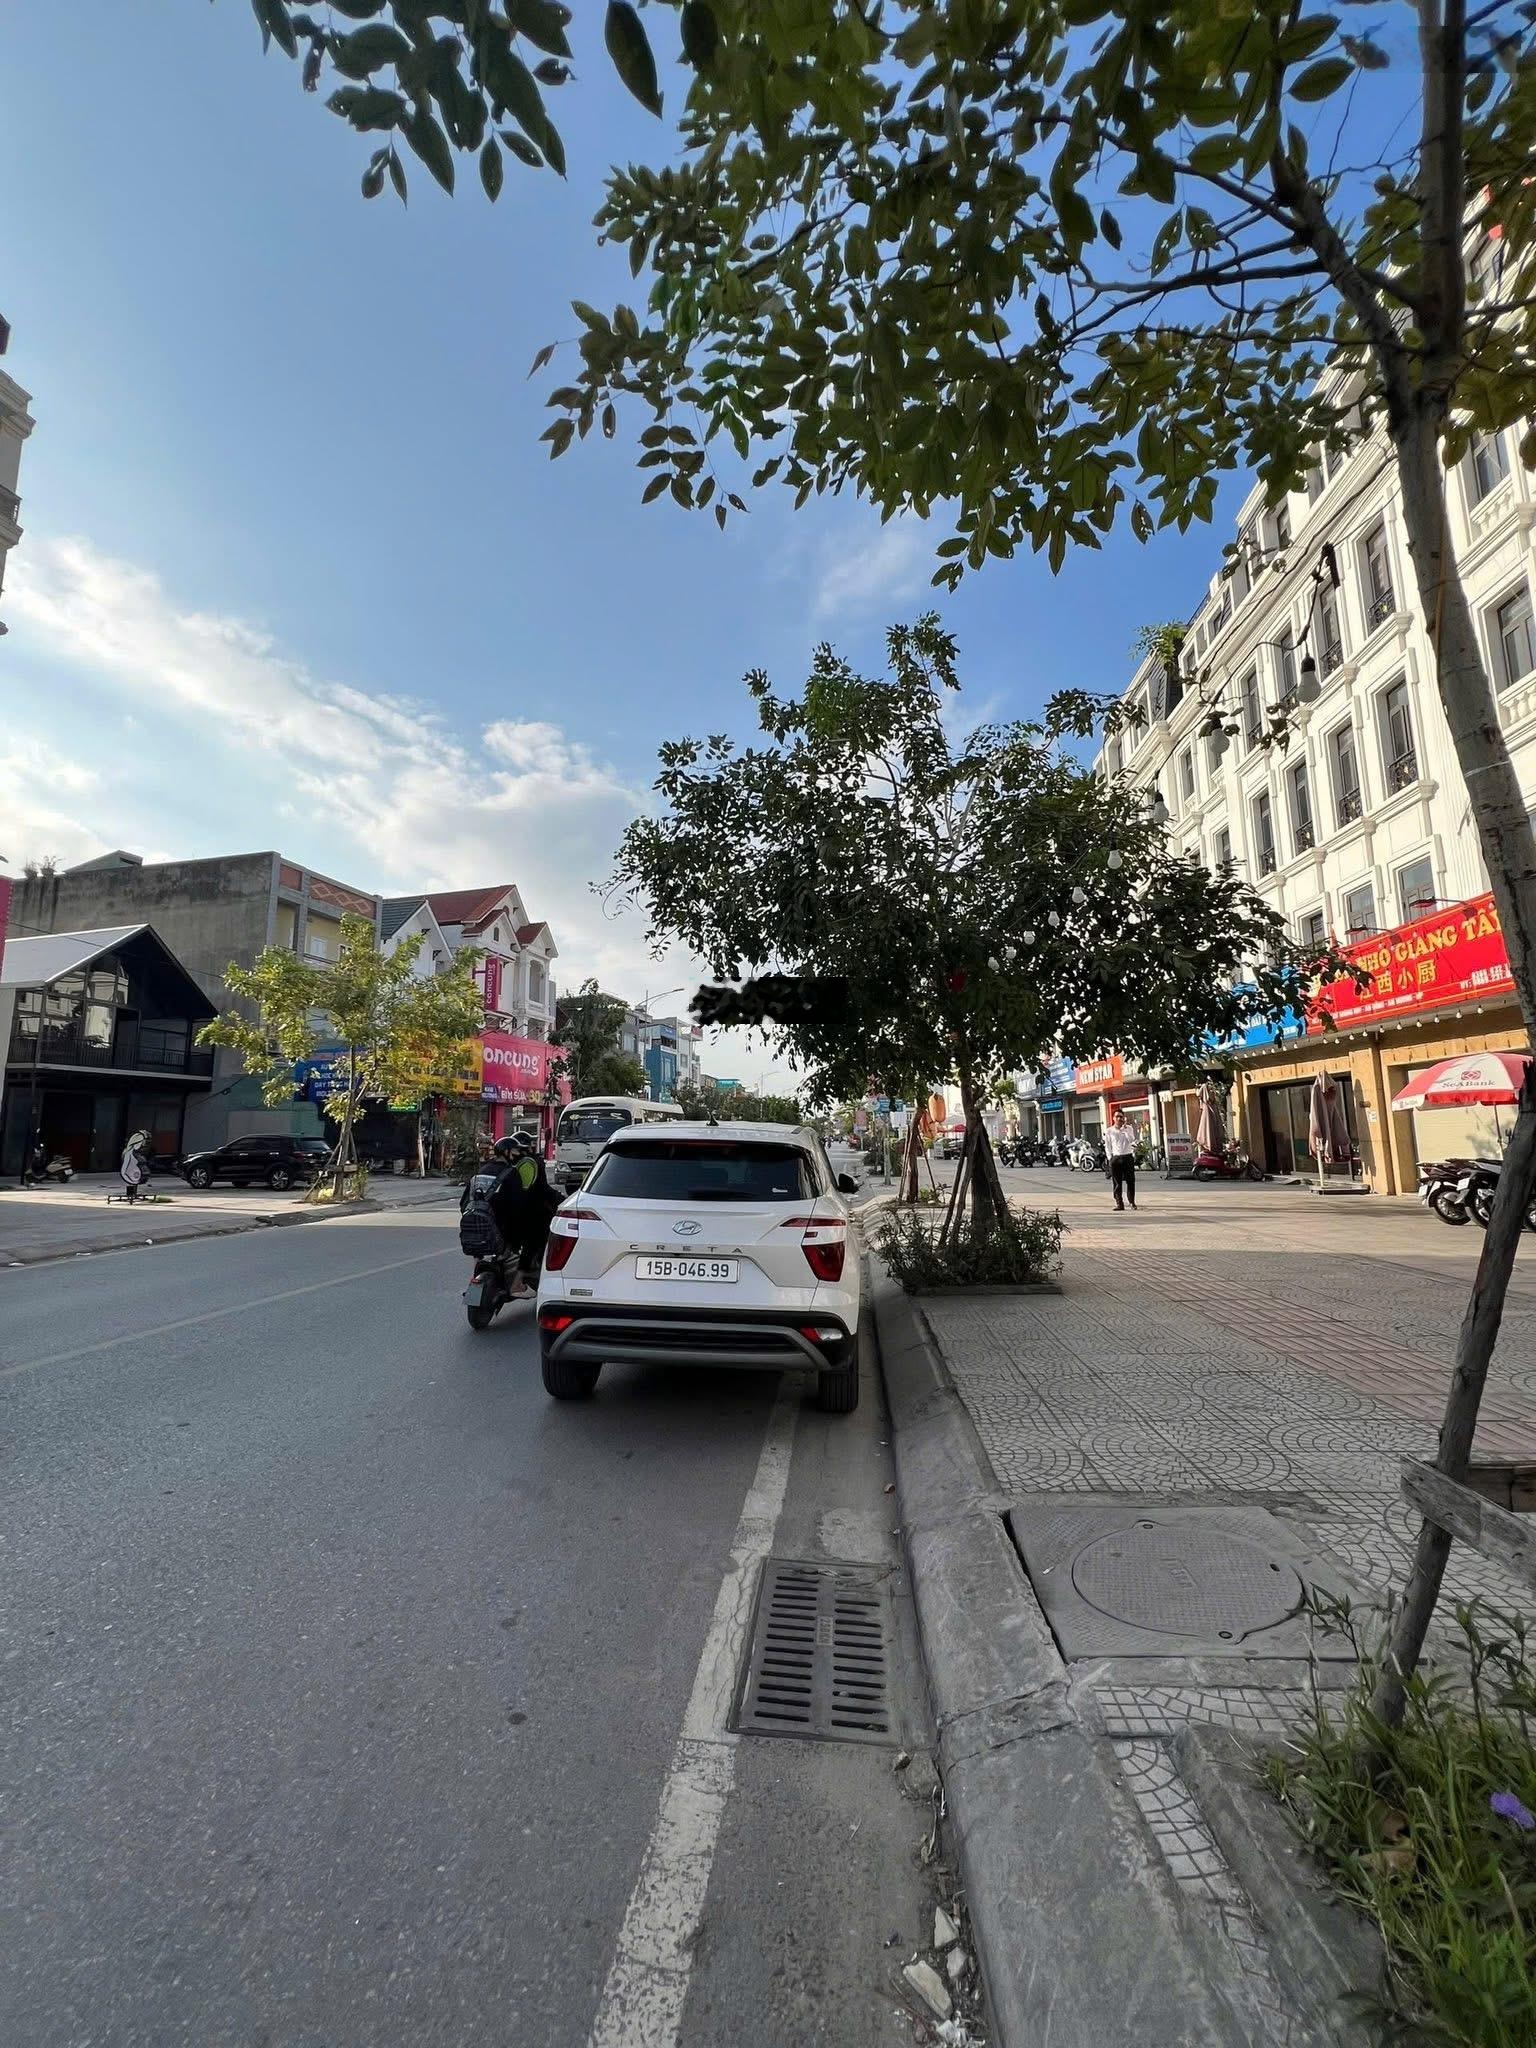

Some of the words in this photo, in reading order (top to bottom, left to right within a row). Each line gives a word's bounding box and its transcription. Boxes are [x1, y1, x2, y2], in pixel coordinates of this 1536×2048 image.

[1395, 925, 1458, 961] GIANG
[629, 1244, 743, 1254] CRETA
[647, 1260, 729, 1278] 15B-046.99
